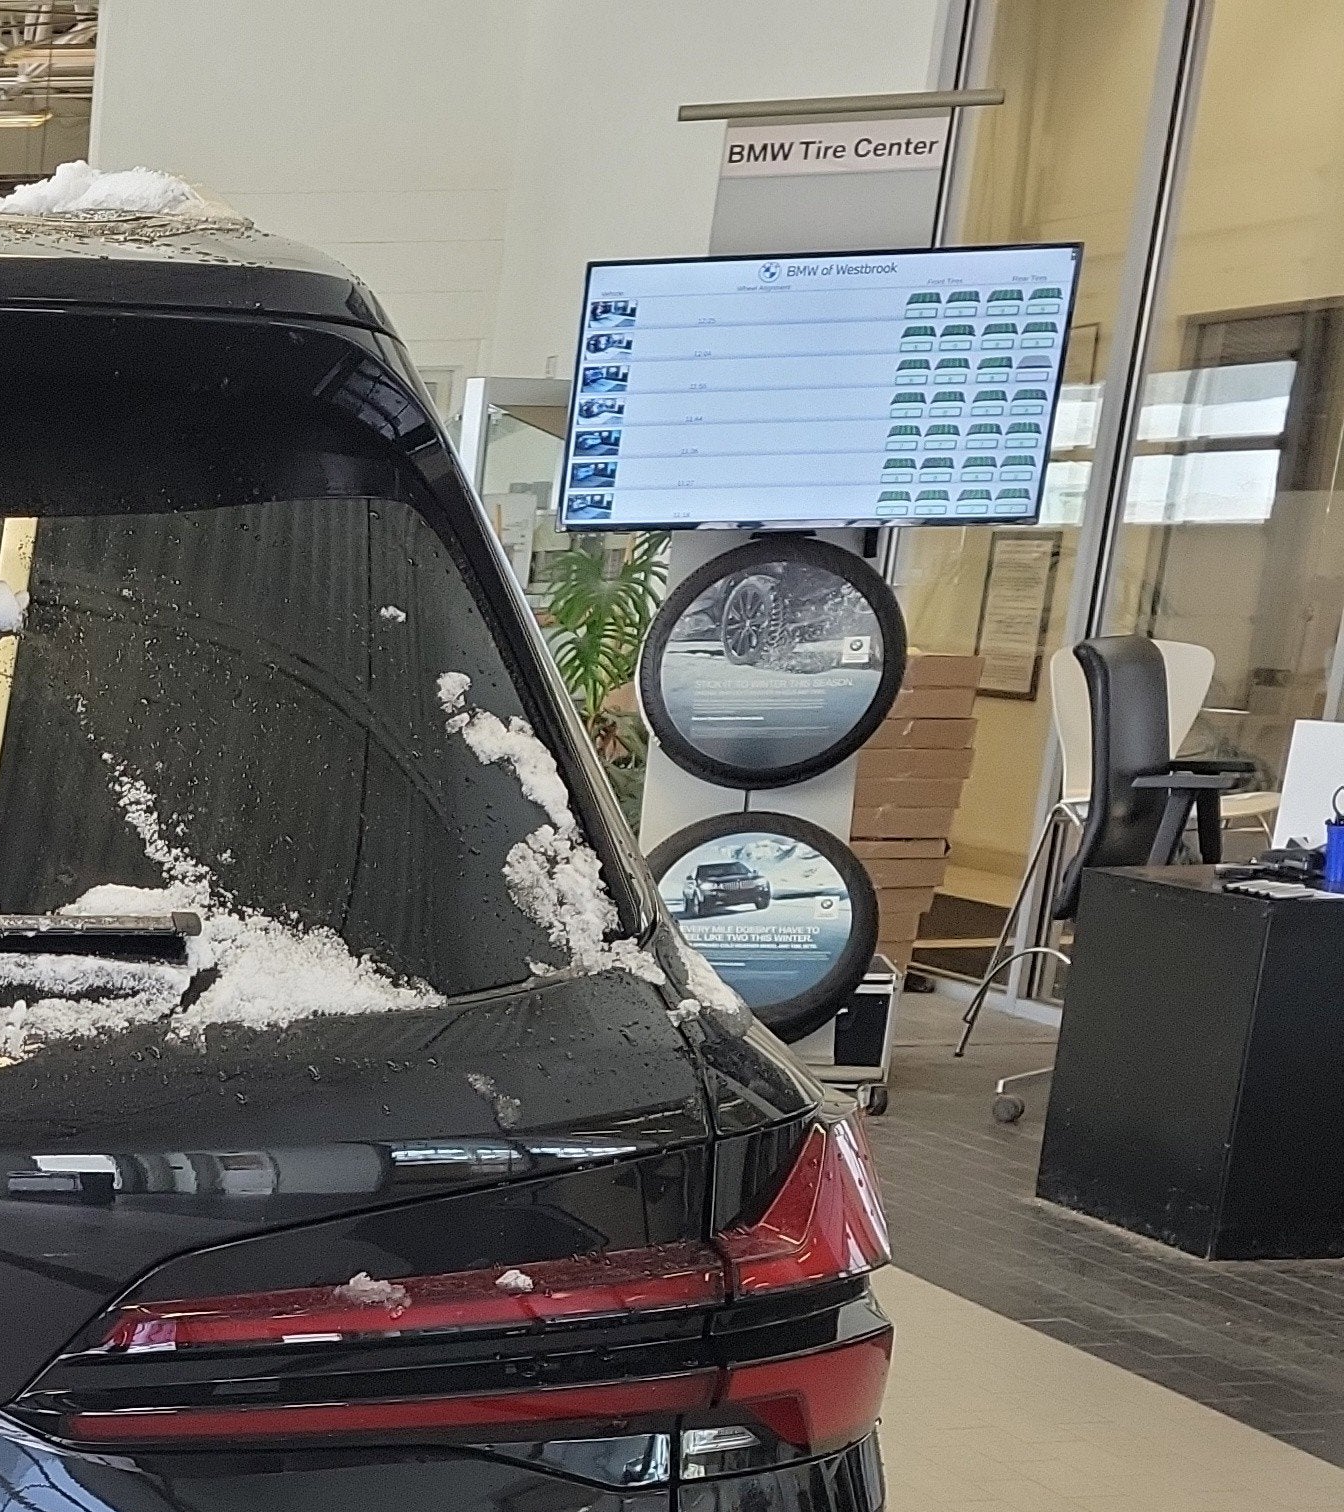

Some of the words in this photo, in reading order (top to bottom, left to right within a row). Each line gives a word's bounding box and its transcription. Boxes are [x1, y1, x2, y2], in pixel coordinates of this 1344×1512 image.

[728, 141, 795, 164] BMW
[799, 139, 847, 160] Tire
[854, 137, 939, 158] Center
[786, 265, 819, 277] BMW
[820, 264, 834, 276] of
[836, 262, 898, 276] Westbrook
[680, 926, 711, 934] EVERY
[712, 926, 734, 934] MILE
[779, 926, 804, 934] HAVE
[807, 926, 820, 934] TO
[685, 933, 703, 941] EEL
[704, 933, 724, 941] LIKE
[726, 933, 748, 941] TWO
[751, 933, 772, 941] THIS
